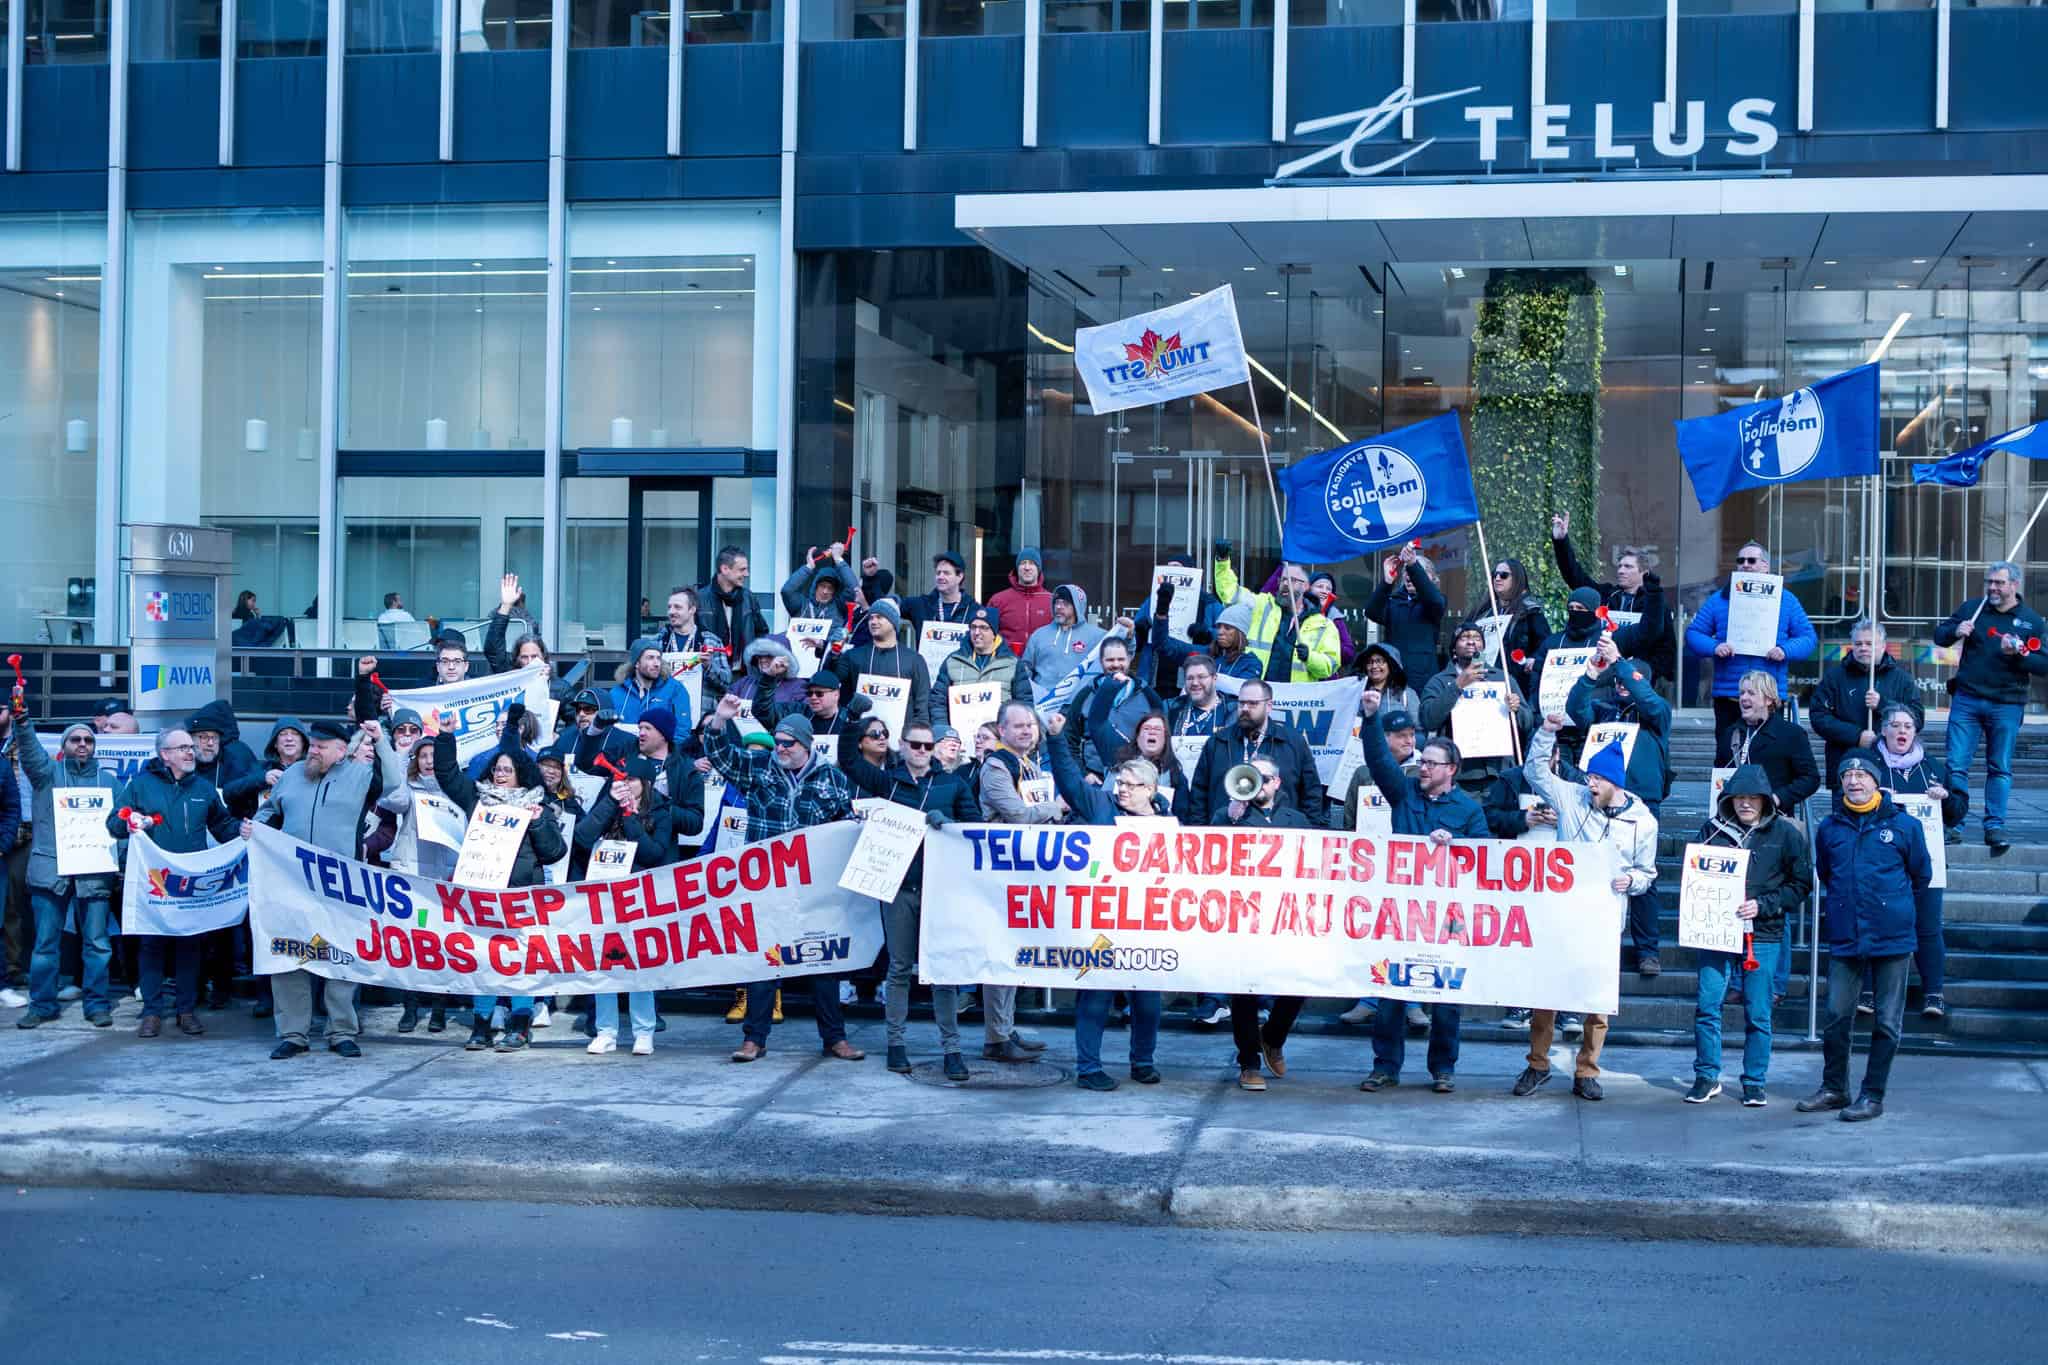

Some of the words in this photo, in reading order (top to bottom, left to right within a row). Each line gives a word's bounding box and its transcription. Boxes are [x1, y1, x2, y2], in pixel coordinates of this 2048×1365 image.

[1464, 98, 1779, 161] TELUS
[168, 532, 193, 556] 630
[1742, 583, 1775, 595] USW
[169, 666, 212, 684] AVIVA
[869, 684, 902, 698] USW
[444, 699, 470, 710] UNITED
[67, 798, 104, 808] USW
[485, 812, 520, 829] USW
[962, 830, 1100, 879] TELUS,
[1112, 832, 1284, 878] GARDEZ
[1295, 834, 1376, 882] LES
[1386, 840, 1575, 893] EMPLOIS
[1698, 857, 1738, 873] USW
[295, 846, 428, 929] TELUS,
[435, 883, 566, 930] KEEP
[575, 833, 812, 925] TELECOM
[1006, 884, 1057, 930] EN
[1065, 874, 1262, 935] TÉLÉCOM
[1271, 892, 1334, 937] AU
[1343, 895, 1534, 948] CANADA
[271, 936, 355, 966] #RISEUP
[356, 918, 478, 974] JOBS
[488, 902, 759, 977] CANADIAN
[781, 936, 851, 966] USW
[1016, 948, 1179, 972] #LEVONSNOUS
[1388, 962, 1468, 990] USW
